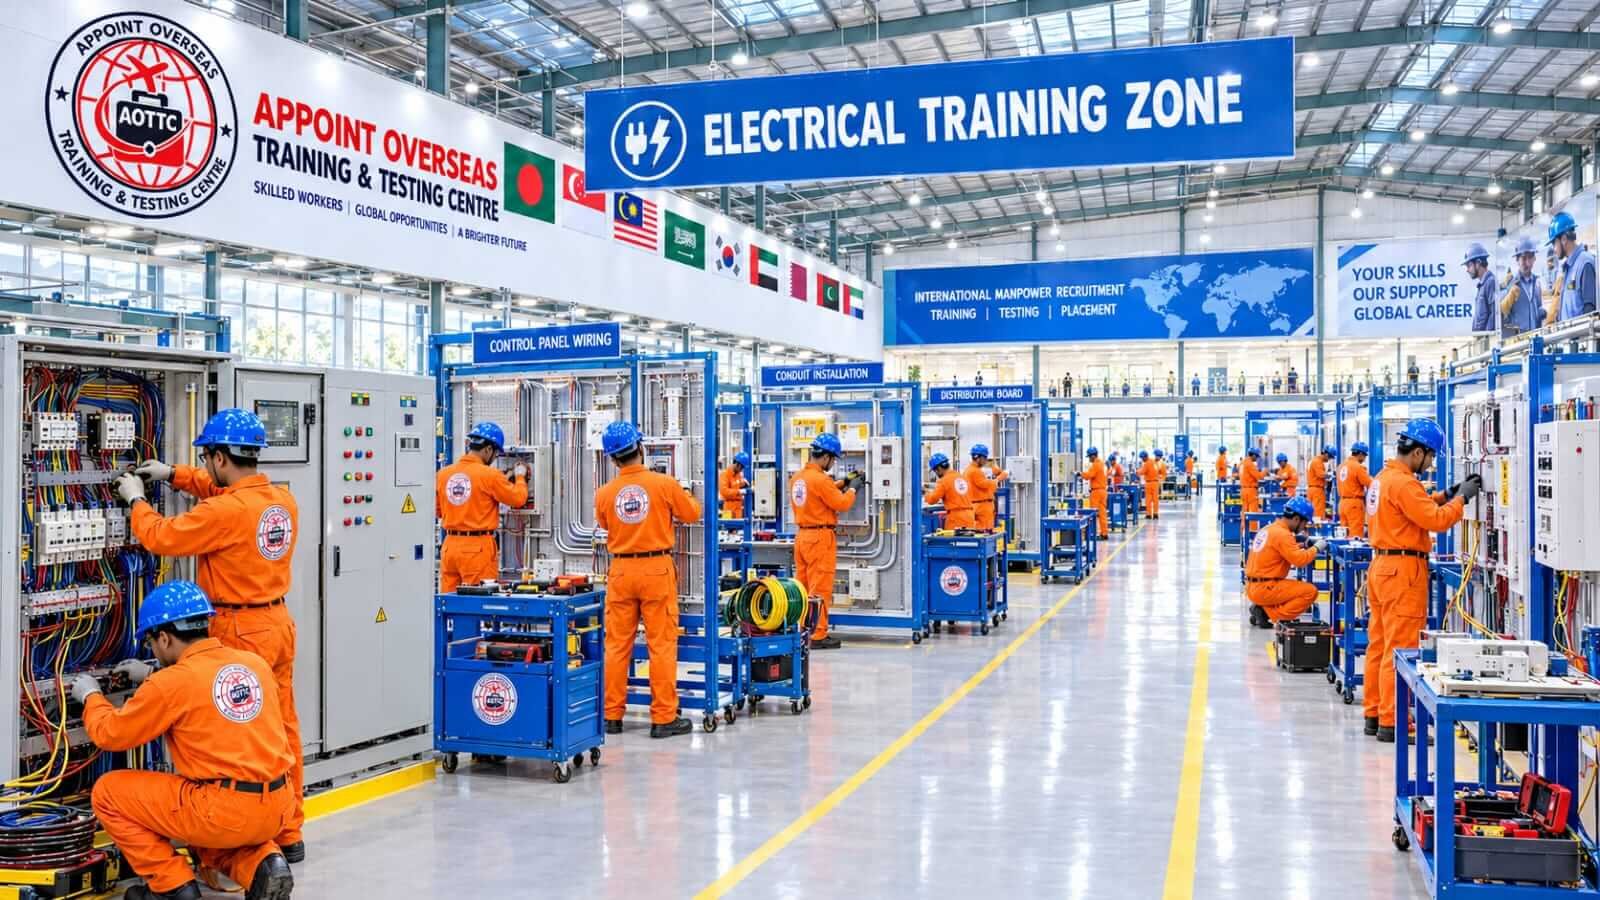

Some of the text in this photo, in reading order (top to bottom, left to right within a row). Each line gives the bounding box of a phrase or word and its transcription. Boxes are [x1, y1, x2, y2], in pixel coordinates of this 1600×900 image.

[75, 20, 219, 80] APPOINT OVERSEAS
[119, 107, 177, 132] AOTTC
[703, 74, 1243, 156] ELECTRICAL TRAINING ZONE
[253, 92, 498, 191] APPOINT OVERSEAS
[59, 129, 227, 211] TRAINING & TESTING CENTRE
[253, 134, 499, 222] TRAINING & TESTING CENTRE
[254, 180, 528, 252] SKILLED WORKERS GLOBAL OPPORTUNITIES A BRIGHTER FUTURE
[1352, 263, 1446, 282] YOUR SKILLS
[915, 283, 1125, 304] INTERNATIONAL MANPOWER RECRUITMENT
[1353, 283, 1458, 302] OUR SUPPORT
[931, 303, 1117, 320] TRAINING TESTING PLACEMENT
[1354, 303, 1473, 321] GLOBAL CAREER
[490, 332, 612, 353] CONTROL PANEL WIRING
[776, 367, 869, 381] CONDUIT INSTALLATION
[941, 388, 1024, 400] DISTRIBUTION BOARD
